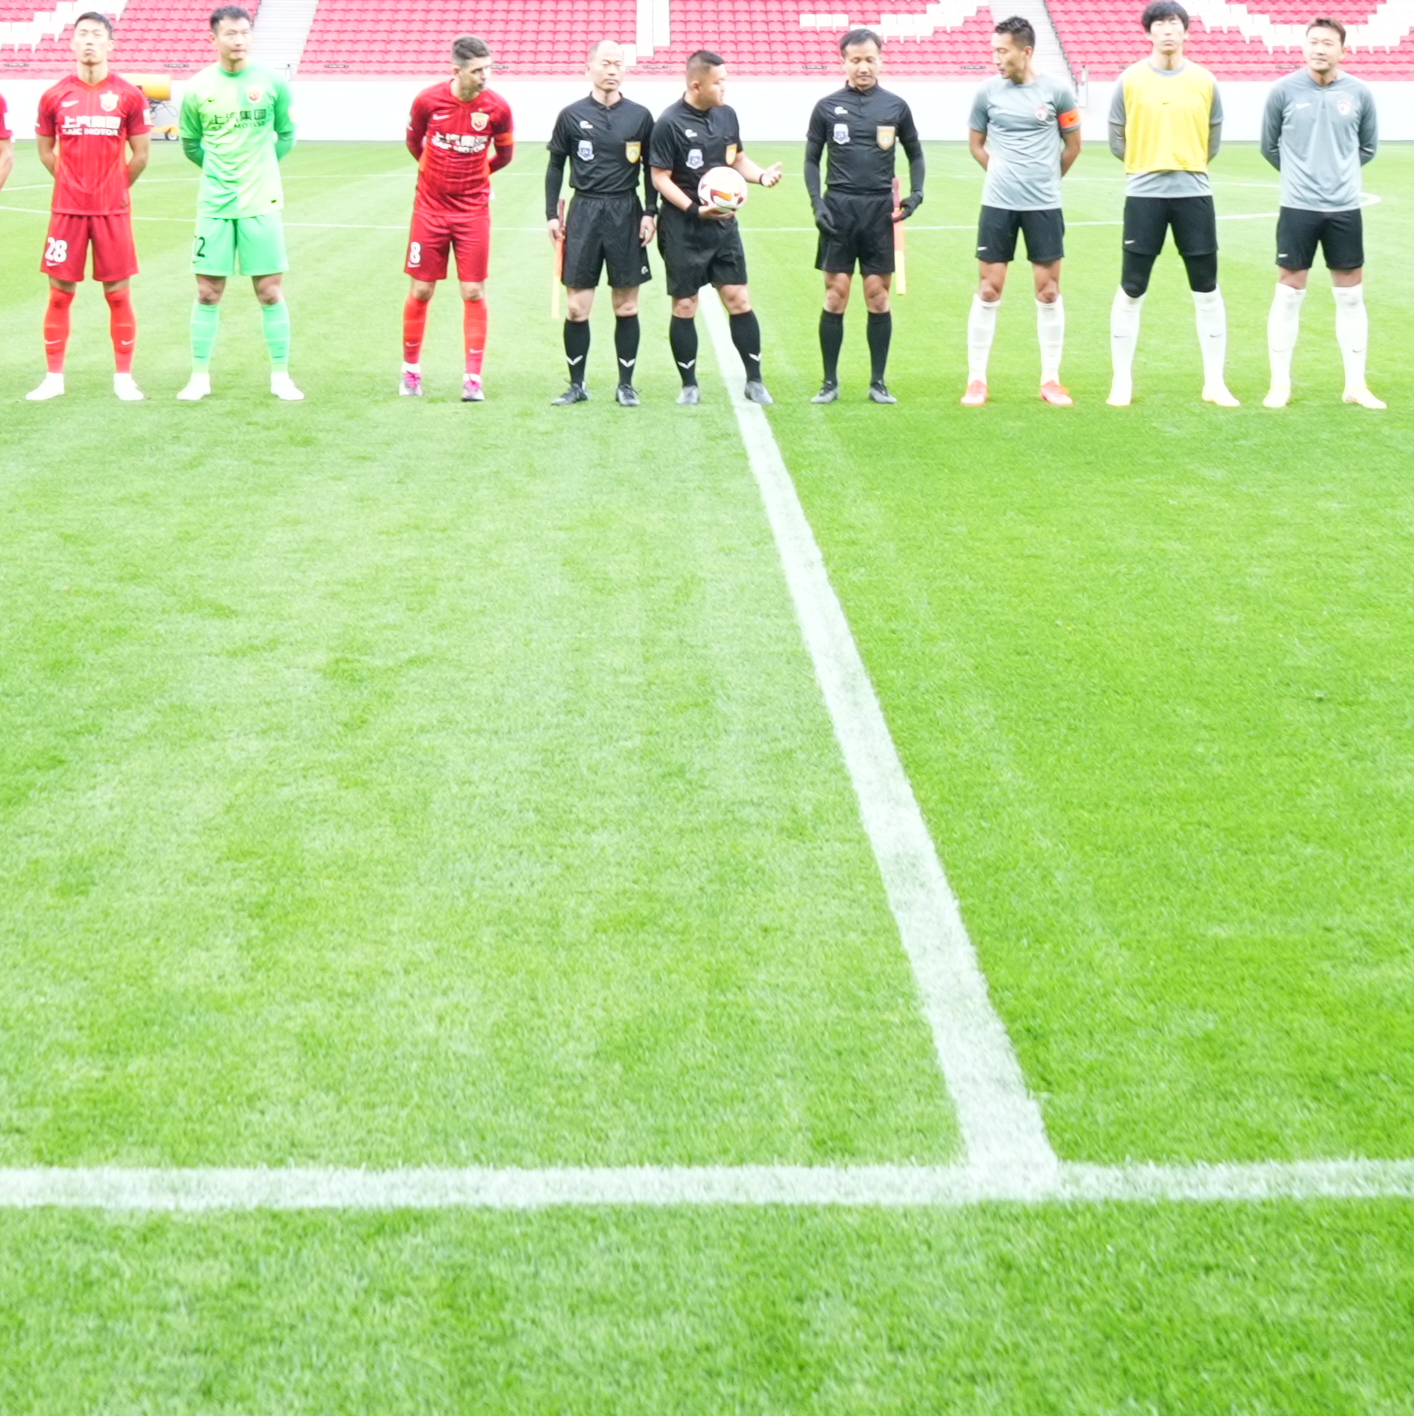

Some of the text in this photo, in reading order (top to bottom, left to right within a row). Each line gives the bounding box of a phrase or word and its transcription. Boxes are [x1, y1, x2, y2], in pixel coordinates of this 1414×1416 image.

[62, 115, 121, 129] 上汽集团
[84, 128, 118, 136] MOTOR
[45, 237, 67, 263] 28
[410, 241, 421, 264] 8
